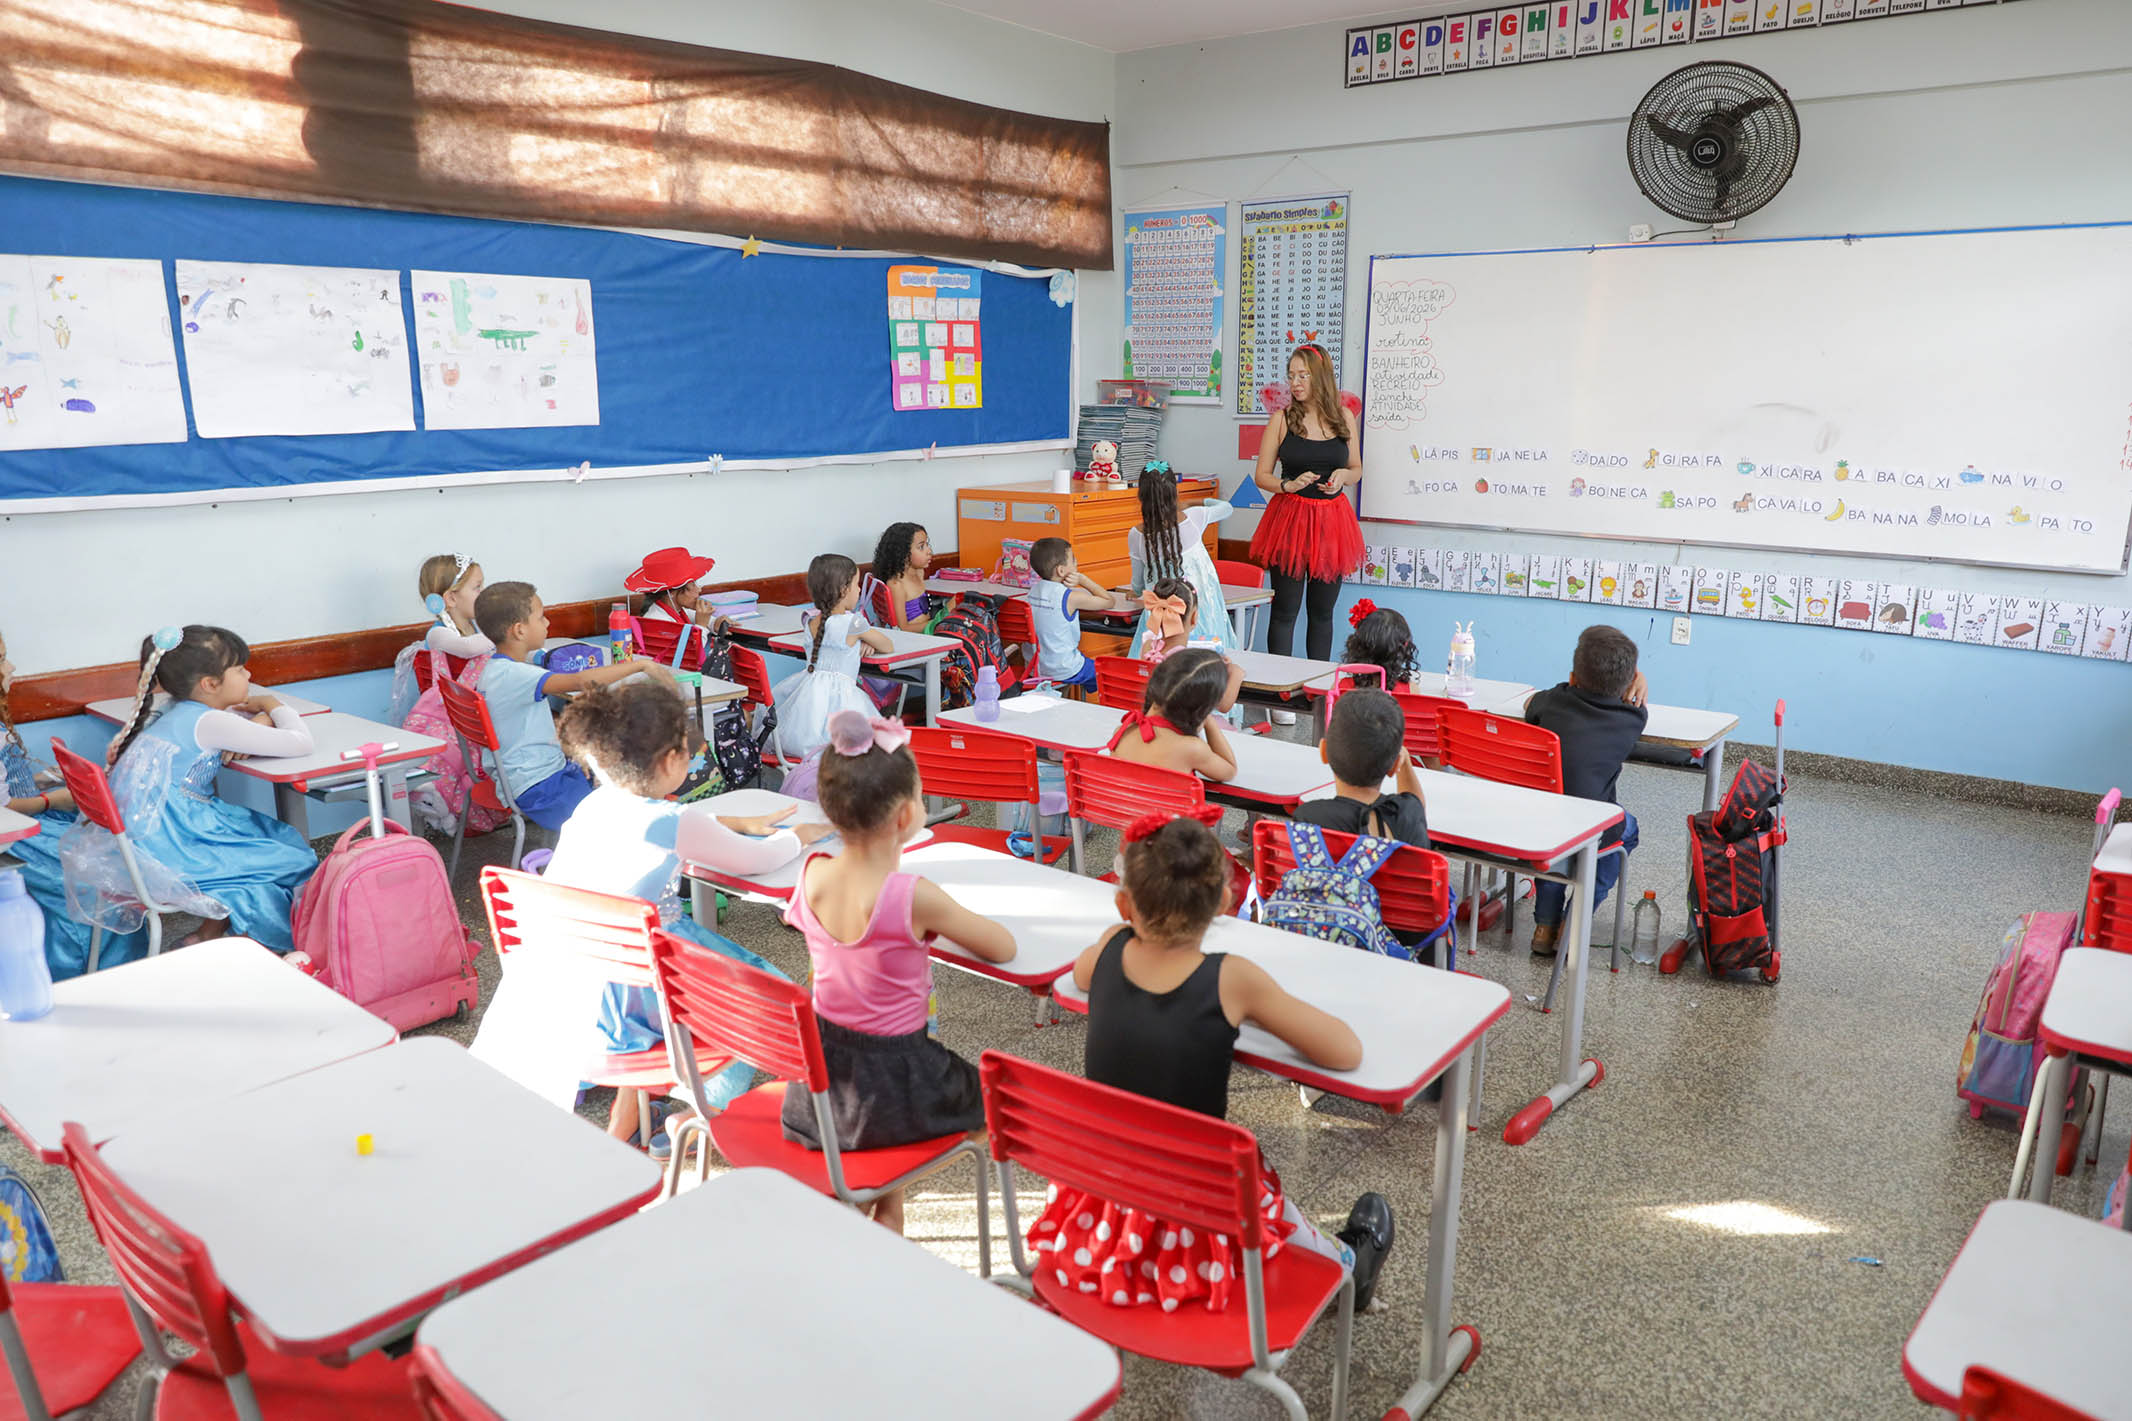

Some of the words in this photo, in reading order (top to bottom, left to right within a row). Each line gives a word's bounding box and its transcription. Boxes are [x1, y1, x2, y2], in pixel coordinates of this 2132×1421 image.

[1609, 0, 1630, 21] K
[1858, 7, 1886, 16] SORVETE
[1891, 2, 1923, 12] TELEFONE
[1558, 6, 1568, 28] I
[1580, 1, 1598, 25] J
[1825, 10, 1852, 20] RELÓGIO
[1500, 14, 1518, 36] G
[1527, 9, 1547, 33] H
[1762, 21, 1778, 29] PATO
[1793, 16, 1815, 25] QUEIJO
[1449, 22, 1465, 44] E
[1477, 18, 1492, 40] F
[1699, 29, 1716, 37] NAVIO
[1400, 29, 1416, 50] C
[1425, 25, 1443, 47] D
[1640, 37, 1656, 45] LÁPIS
[1668, 33, 1685, 42] MAÇÃ
[1351, 36, 1369, 57] A
[1376, 32, 1392, 54] B
[1284, 207, 1318, 219] Simples
[1182, 216, 1187, 225] 0
[1190, 215, 1208, 225] 1000
[1379, 312, 1422, 326] JUNHO
[1376, 330, 1430, 347] rotina
[1371, 355, 1430, 370] BANHEIRO
[1372, 370, 1440, 381] atividade
[1372, 379, 1421, 391] RECREIO
[1370, 400, 1424, 412] ATIVIDADE
[1366, 545, 1373, 554] D
[1391, 547, 1398, 556] E
[1420, 549, 1425, 557] F
[1446, 551, 1454, 560] G
[1474, 552, 1482, 561] H
[1534, 556, 1541, 565] J
[1565, 558, 1573, 567] K
[1627, 563, 1638, 573] M
[1662, 566, 1671, 576] N
[1697, 568, 1707, 578] O
[1732, 572, 1741, 581] P
[1767, 574, 1777, 585] Q
[1804, 577, 1813, 587] R
[1843, 580, 1852, 591] S
[1883, 584, 1891, 594] T
[1923, 589, 1933, 600] U
[1964, 594, 1974, 604] V
[2005, 598, 2019, 609] W
[2049, 602, 2060, 613] X
[2094, 607, 2105, 617] Y
[2092, 650, 2117, 658] YAKULT
